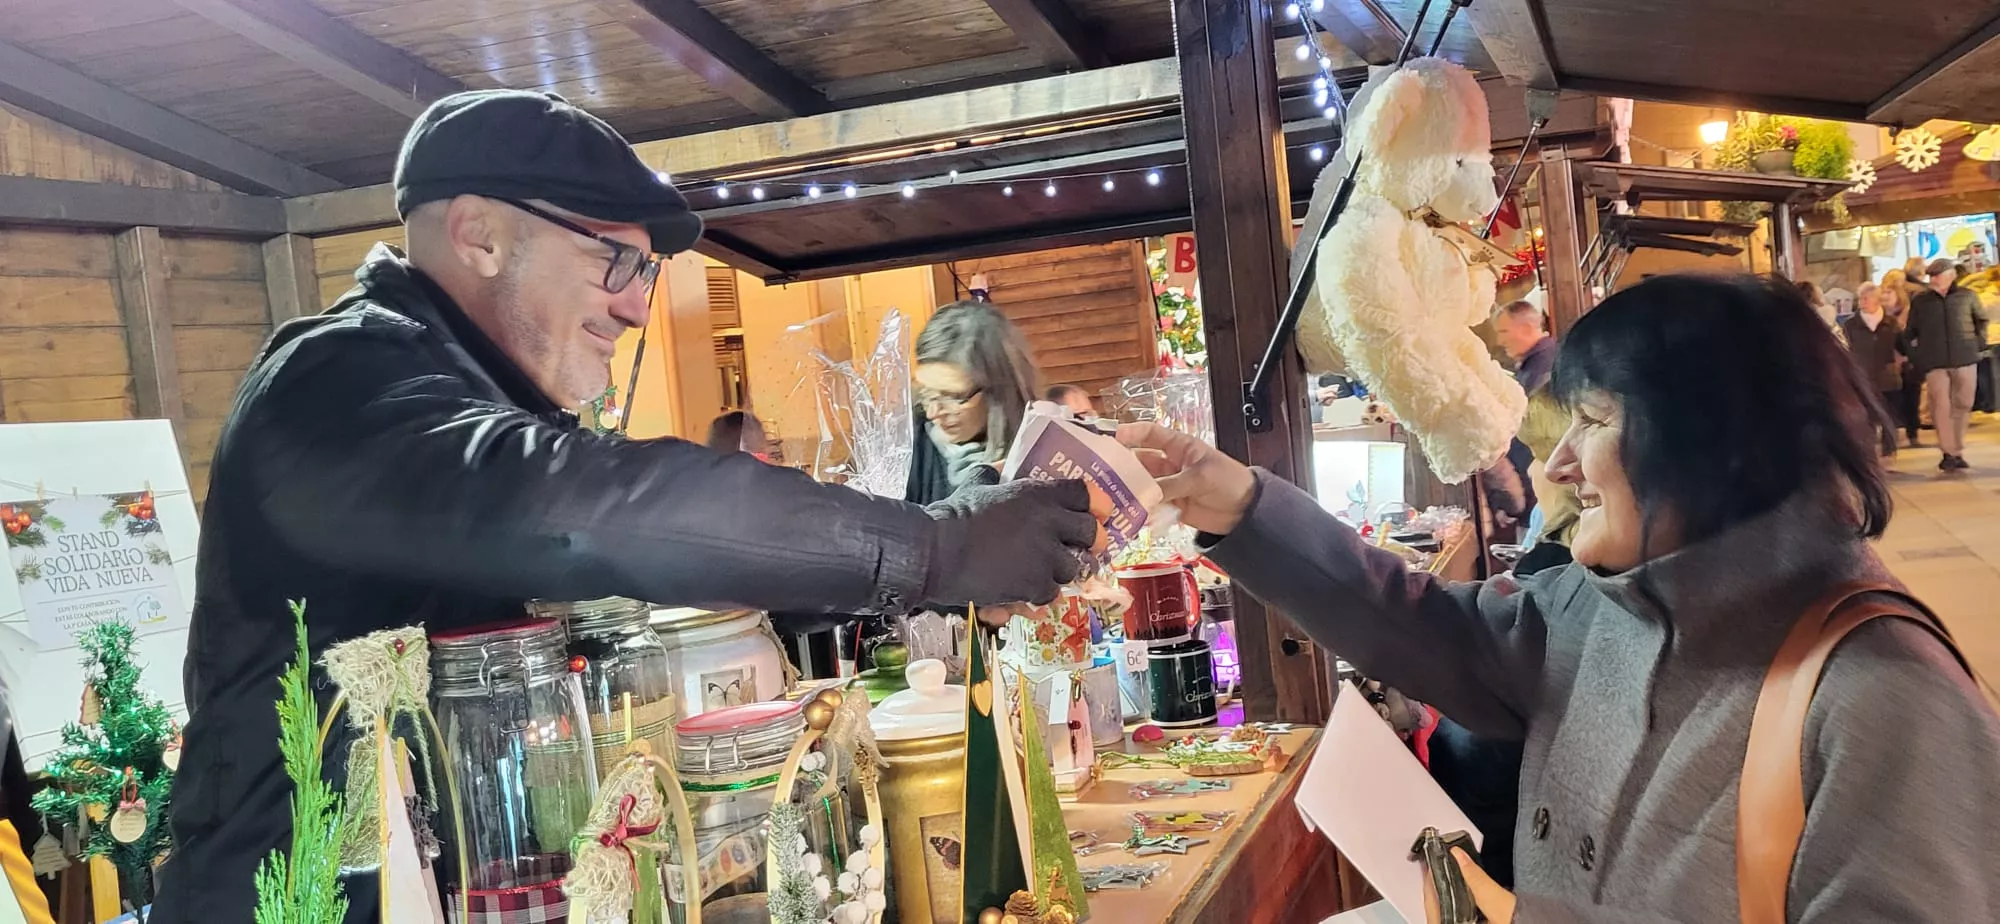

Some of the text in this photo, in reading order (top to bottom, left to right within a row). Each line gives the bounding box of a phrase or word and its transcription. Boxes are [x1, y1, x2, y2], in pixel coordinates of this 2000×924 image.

[1174, 236, 1197, 273] B
[57, 530, 120, 553] STAND
[44, 547, 144, 576] SOLIDARIO
[45, 566, 154, 595] VIDA NUEVA
